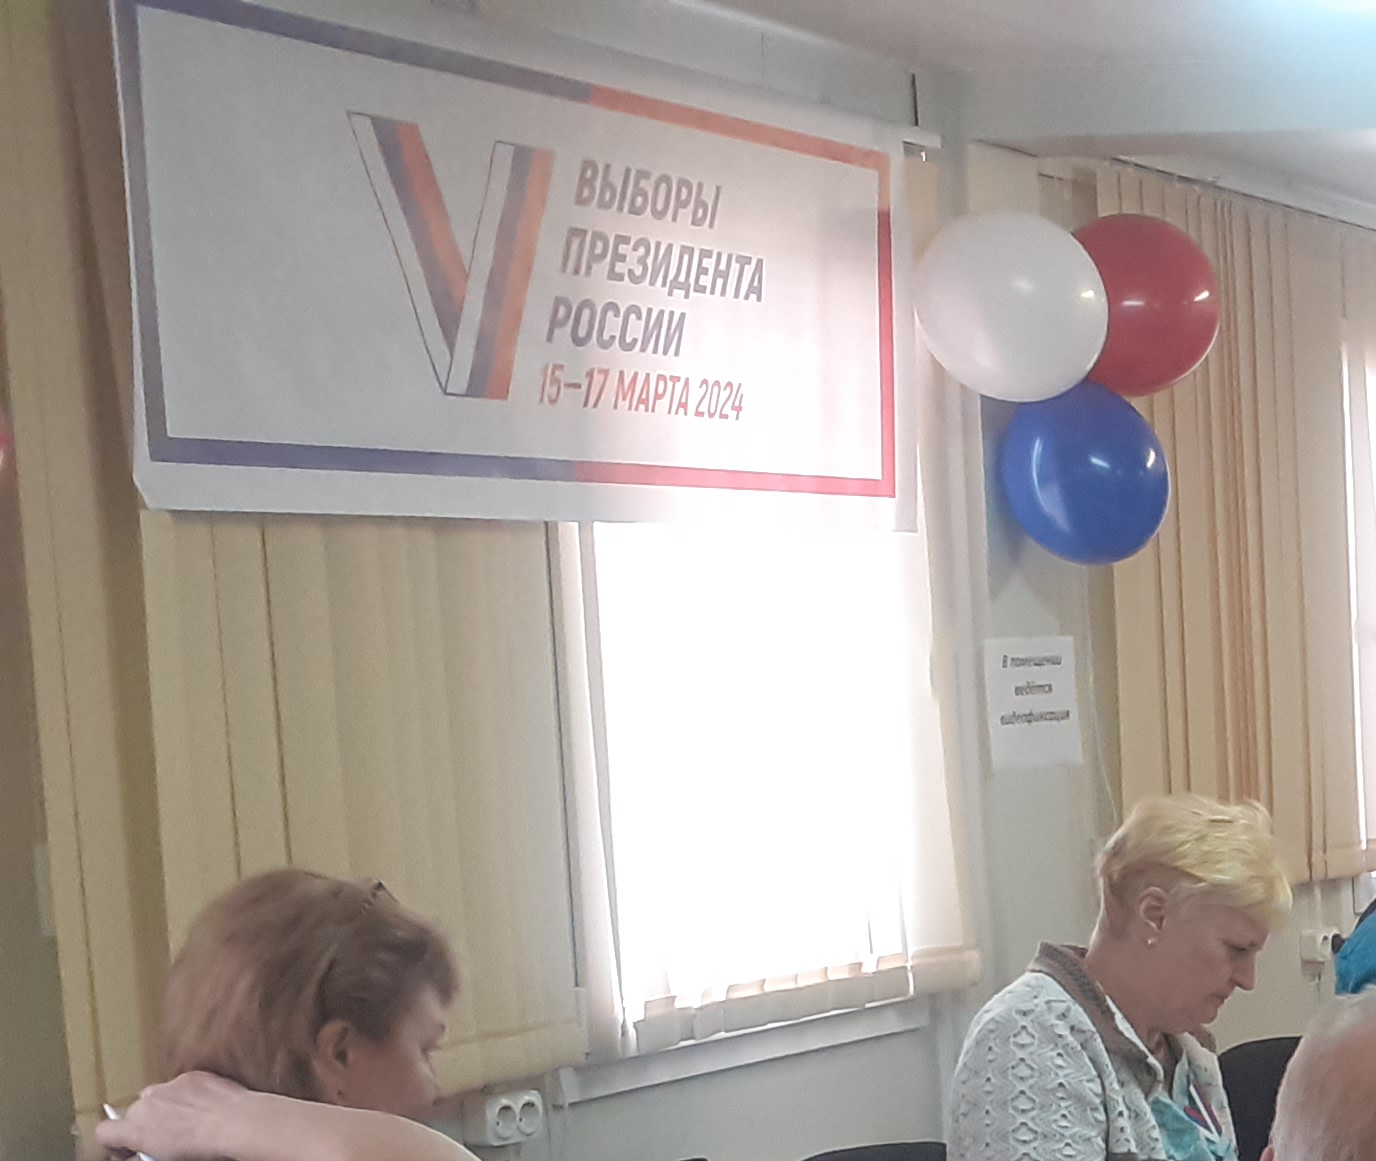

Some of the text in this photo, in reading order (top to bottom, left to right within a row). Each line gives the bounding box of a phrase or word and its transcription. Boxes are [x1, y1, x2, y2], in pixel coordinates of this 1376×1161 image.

[573, 157, 722, 230] ВЫБОРЫ
[560, 225, 765, 303] ПРЕЗИДЕНТА
[545, 295, 687, 358] РОССИИ
[612, 369, 691, 417] МАРТА
[693, 377, 745, 422] 2024
